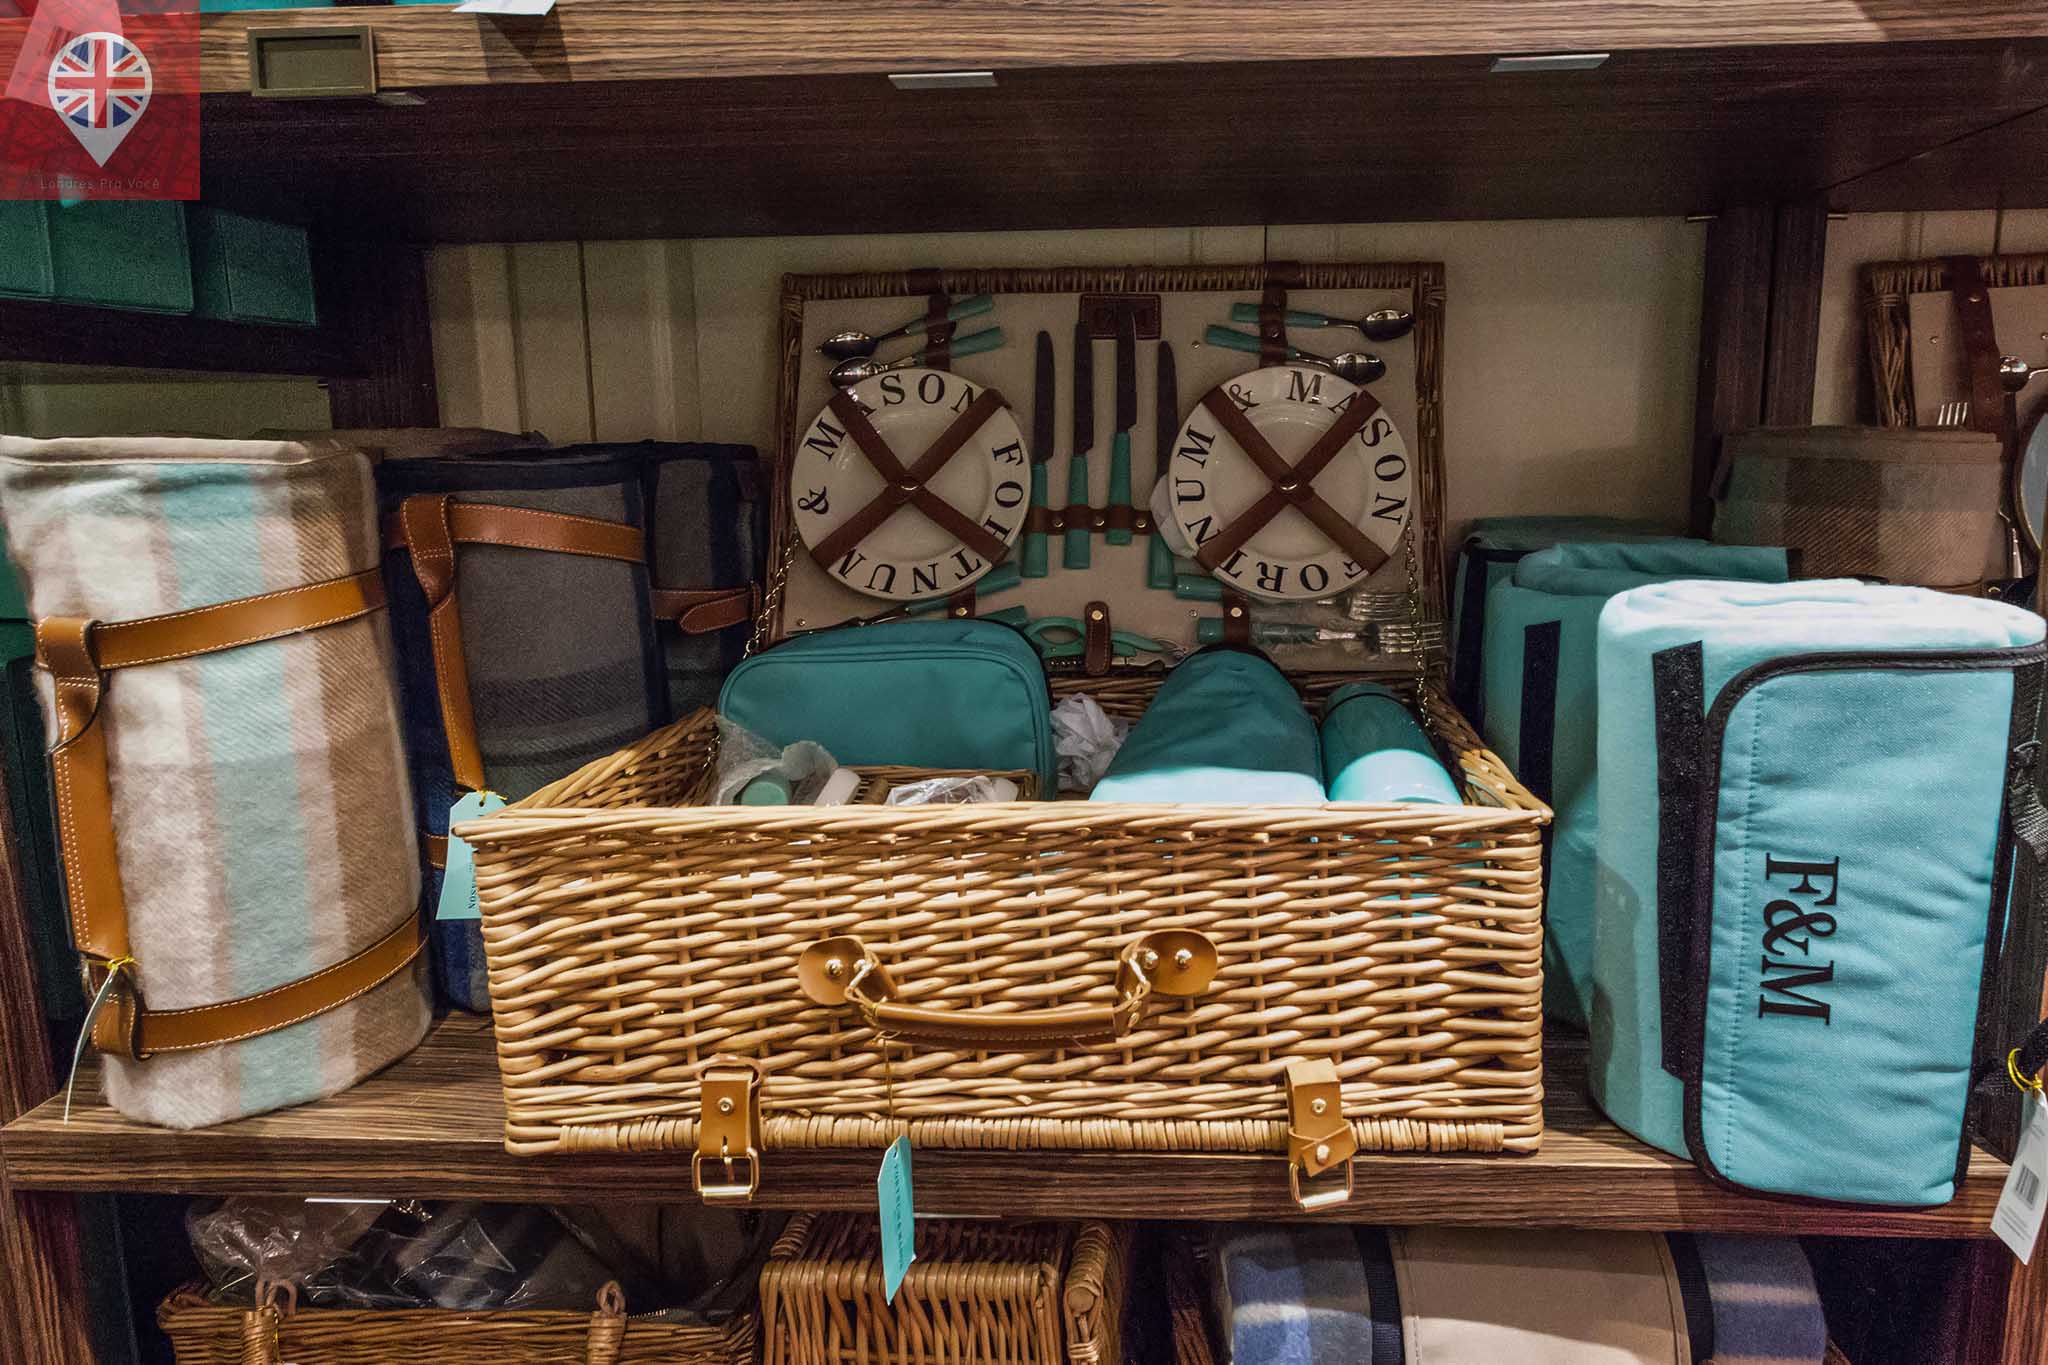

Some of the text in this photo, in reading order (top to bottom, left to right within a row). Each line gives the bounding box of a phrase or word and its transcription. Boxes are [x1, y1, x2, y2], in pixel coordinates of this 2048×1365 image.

[1228, 383, 1260, 414] &
[797, 486, 829, 516] &
[1758, 852, 1840, 1026] F&M
